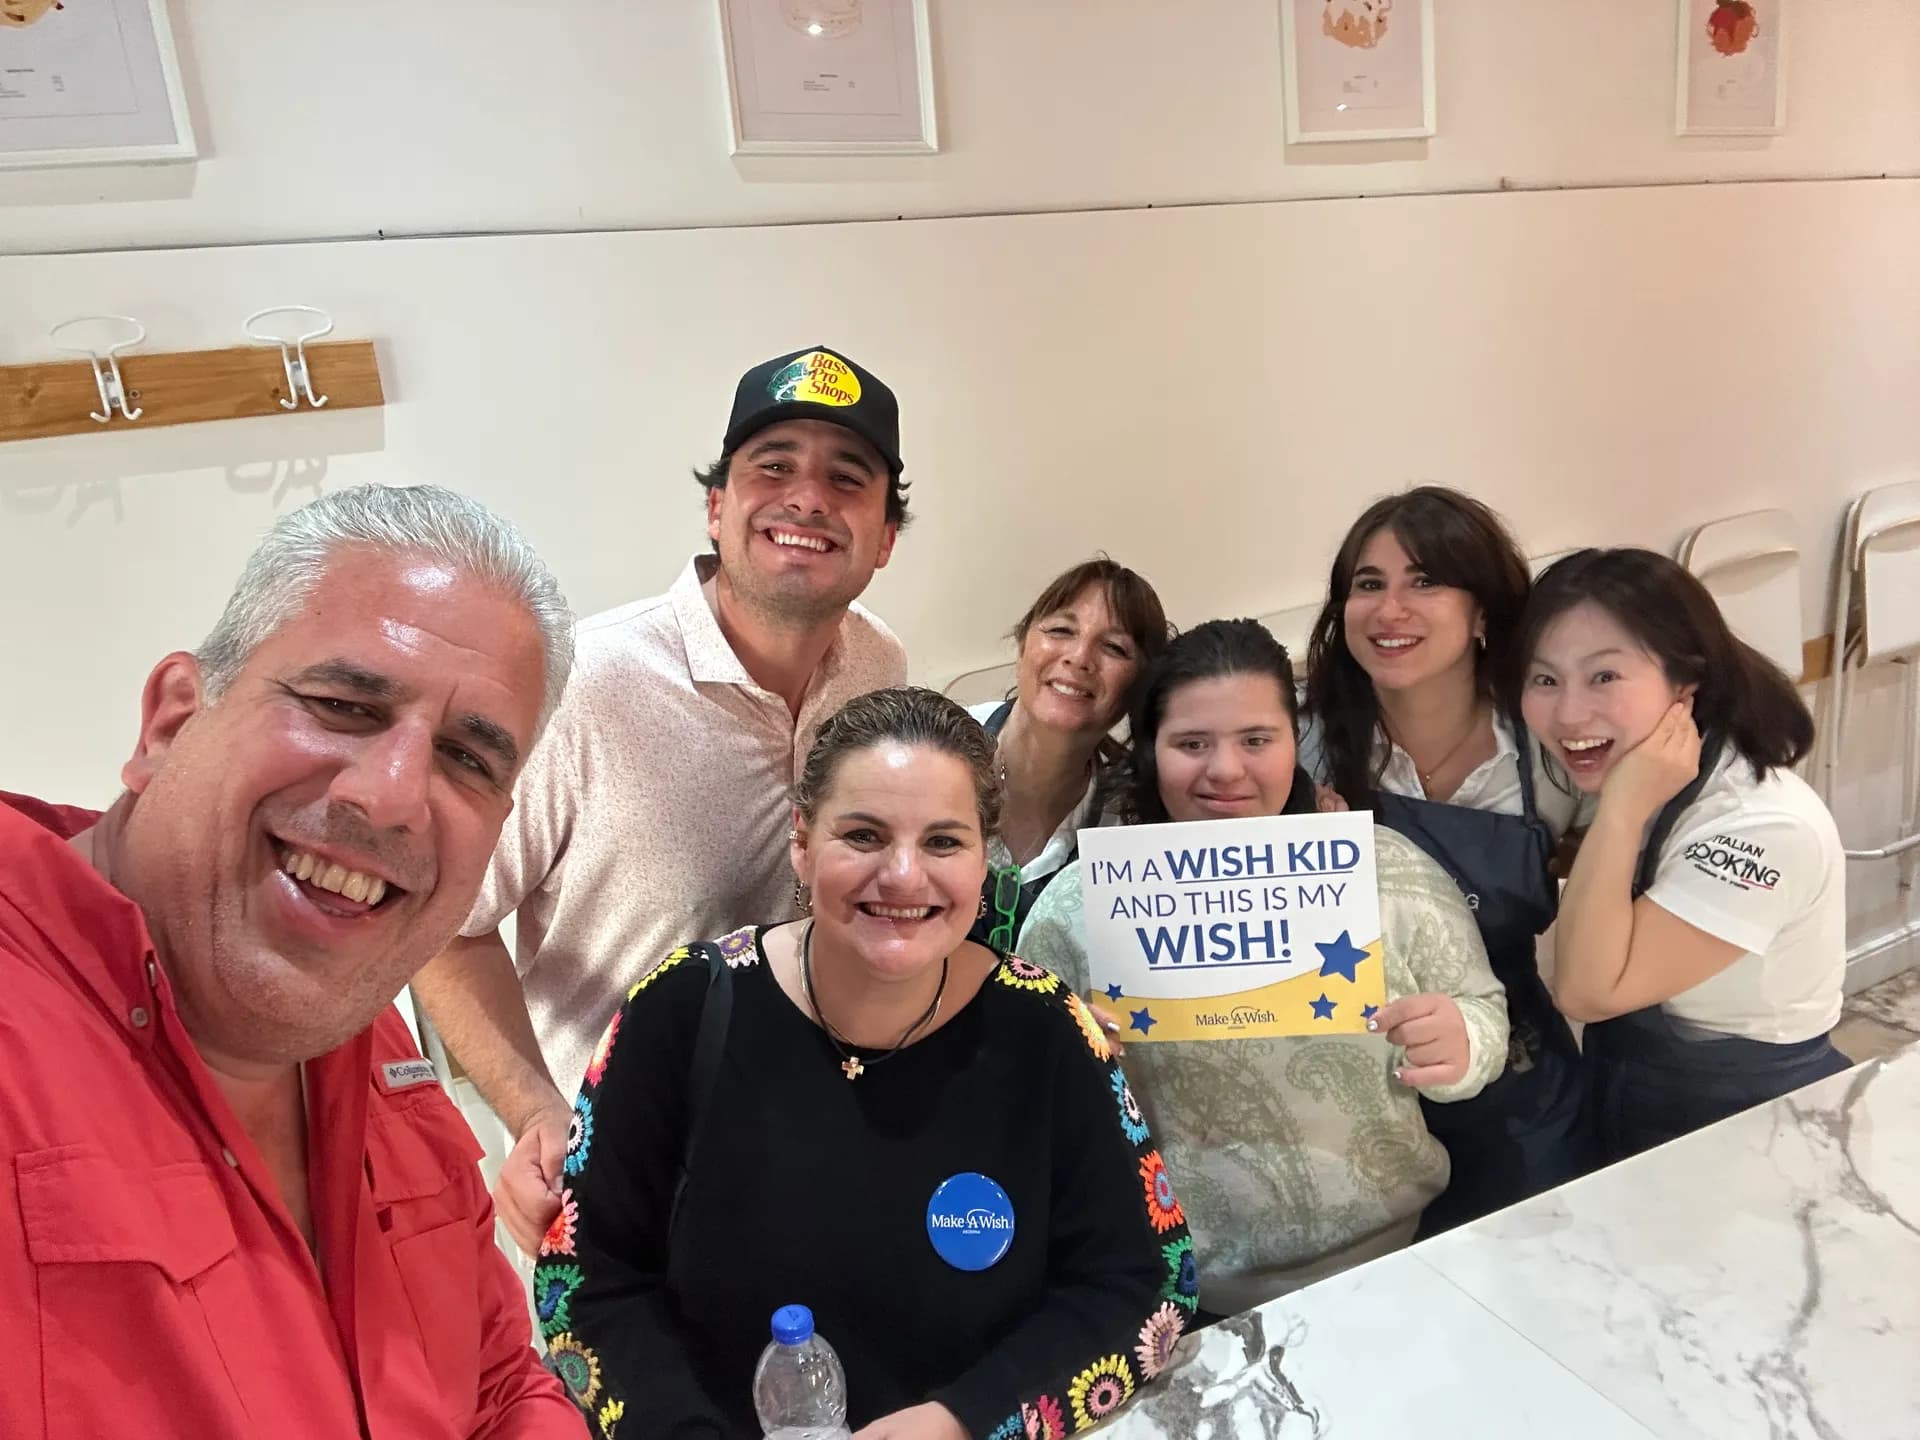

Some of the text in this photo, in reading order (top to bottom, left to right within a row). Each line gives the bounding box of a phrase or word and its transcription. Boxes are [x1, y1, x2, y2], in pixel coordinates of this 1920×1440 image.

[808, 368, 838, 384] Pro
[811, 354, 848, 375] Bass
[808, 381, 855, 404] Shops
[1713, 834, 1765, 858] ITALIAN
[1091, 839, 1360, 885] I'M A WISH KID
[1110, 883, 1346, 919] AND THIS IS MY
[1136, 919, 1292, 964] WISH!
